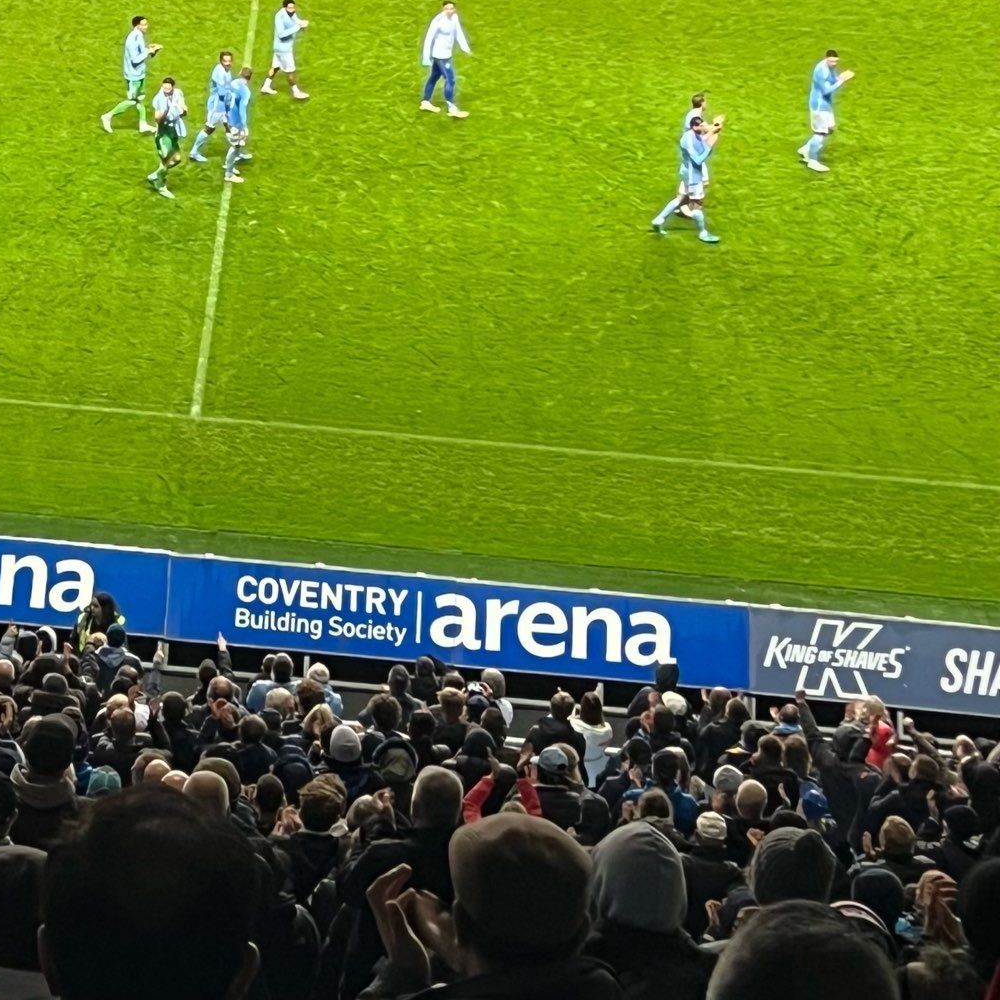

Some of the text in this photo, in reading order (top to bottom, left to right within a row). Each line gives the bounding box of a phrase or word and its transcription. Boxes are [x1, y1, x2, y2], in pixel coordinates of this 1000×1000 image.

[236, 574, 409, 616] COVENTRY
[234, 607, 408, 648] Building Society
[430, 591, 678, 667] arena
[763, 635, 818, 670] KING
[830, 648, 906, 679] SHAVES
